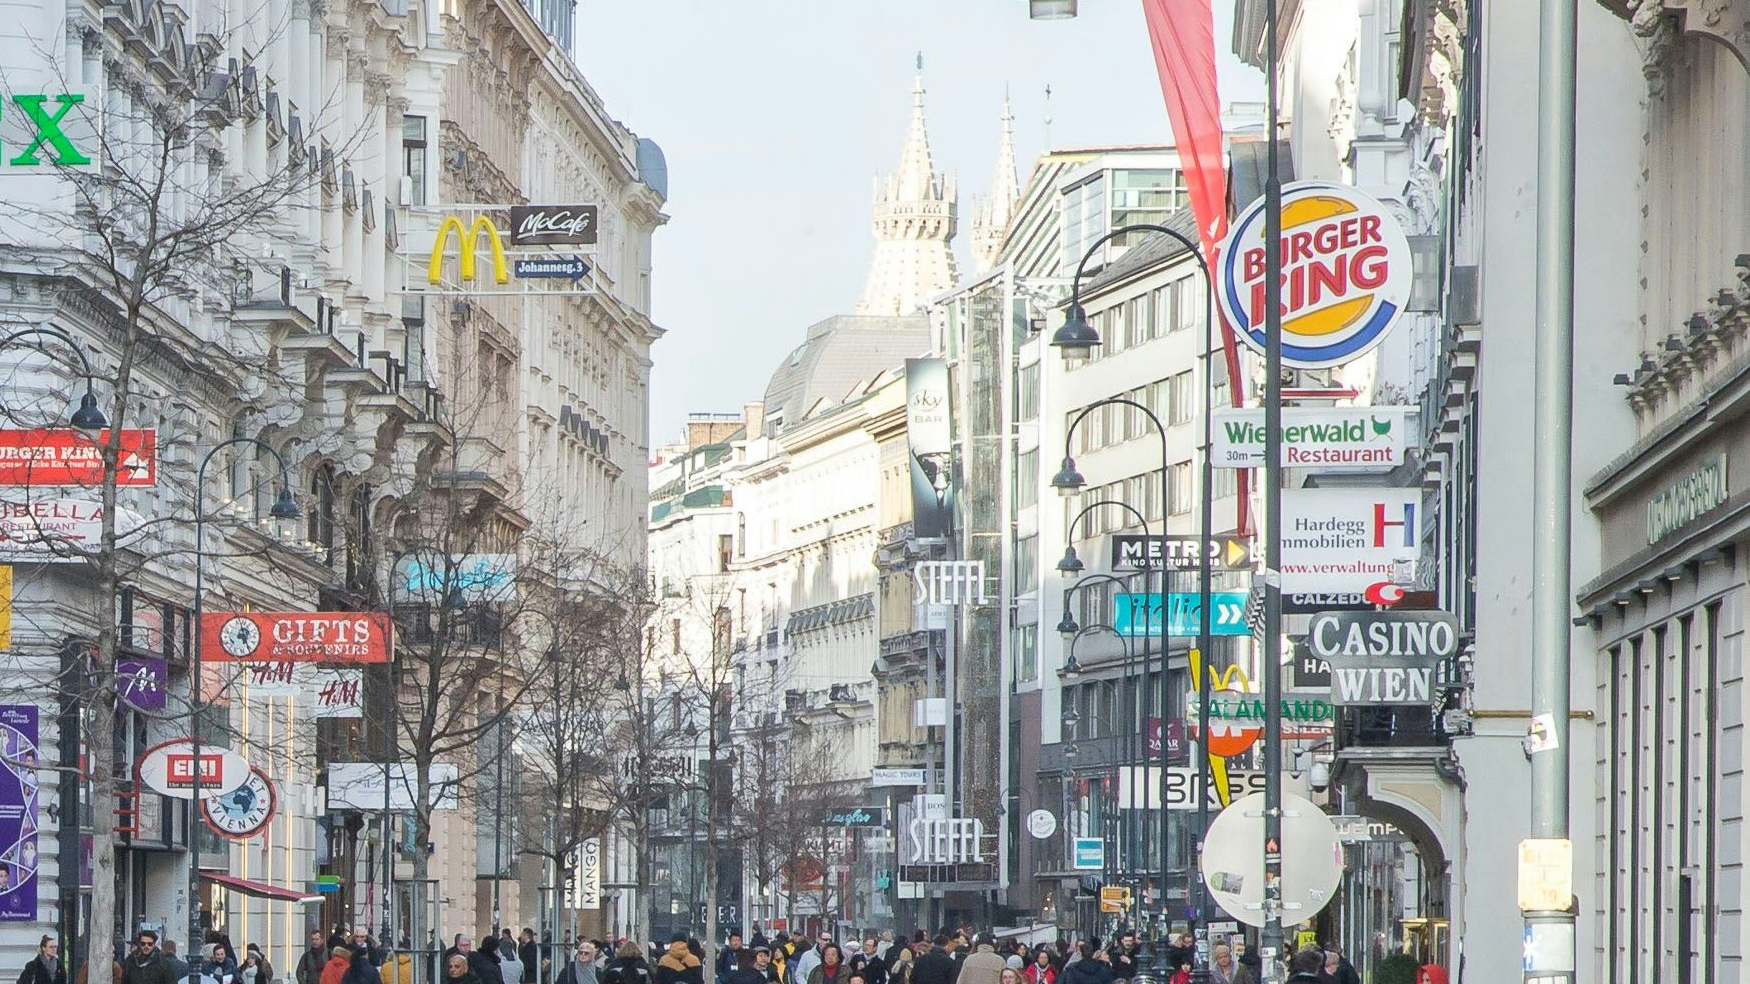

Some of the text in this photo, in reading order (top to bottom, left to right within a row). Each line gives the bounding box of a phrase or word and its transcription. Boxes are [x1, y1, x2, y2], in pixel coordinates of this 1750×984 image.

[1250, 245, 1389, 329] KING
[1224, 418, 1365, 444] Wieerwald
[1226, 446, 1392, 463] 30m Restaurant
[1295, 517, 1366, 536] Hardegg
[1121, 540, 1221, 558] METRO
[1281, 534, 1366, 550] mmobilien
[1121, 558, 1146, 567] KINO
[1150, 558, 1189, 567] KUTUR
[1280, 560, 1395, 577] ww.verwaltung
[913, 560, 989, 605] STEFFL
[272, 619, 370, 643] GIFTS
[1313, 616, 1454, 657] CASINO
[319, 679, 359, 707] H&M
[1335, 668, 1432, 702] WIEN
[1148, 738, 1179, 750] QAAR
[212, 806, 267, 830] VIENNA
[909, 817, 985, 863] STEFFL
[585, 842, 597, 904] MANGO
